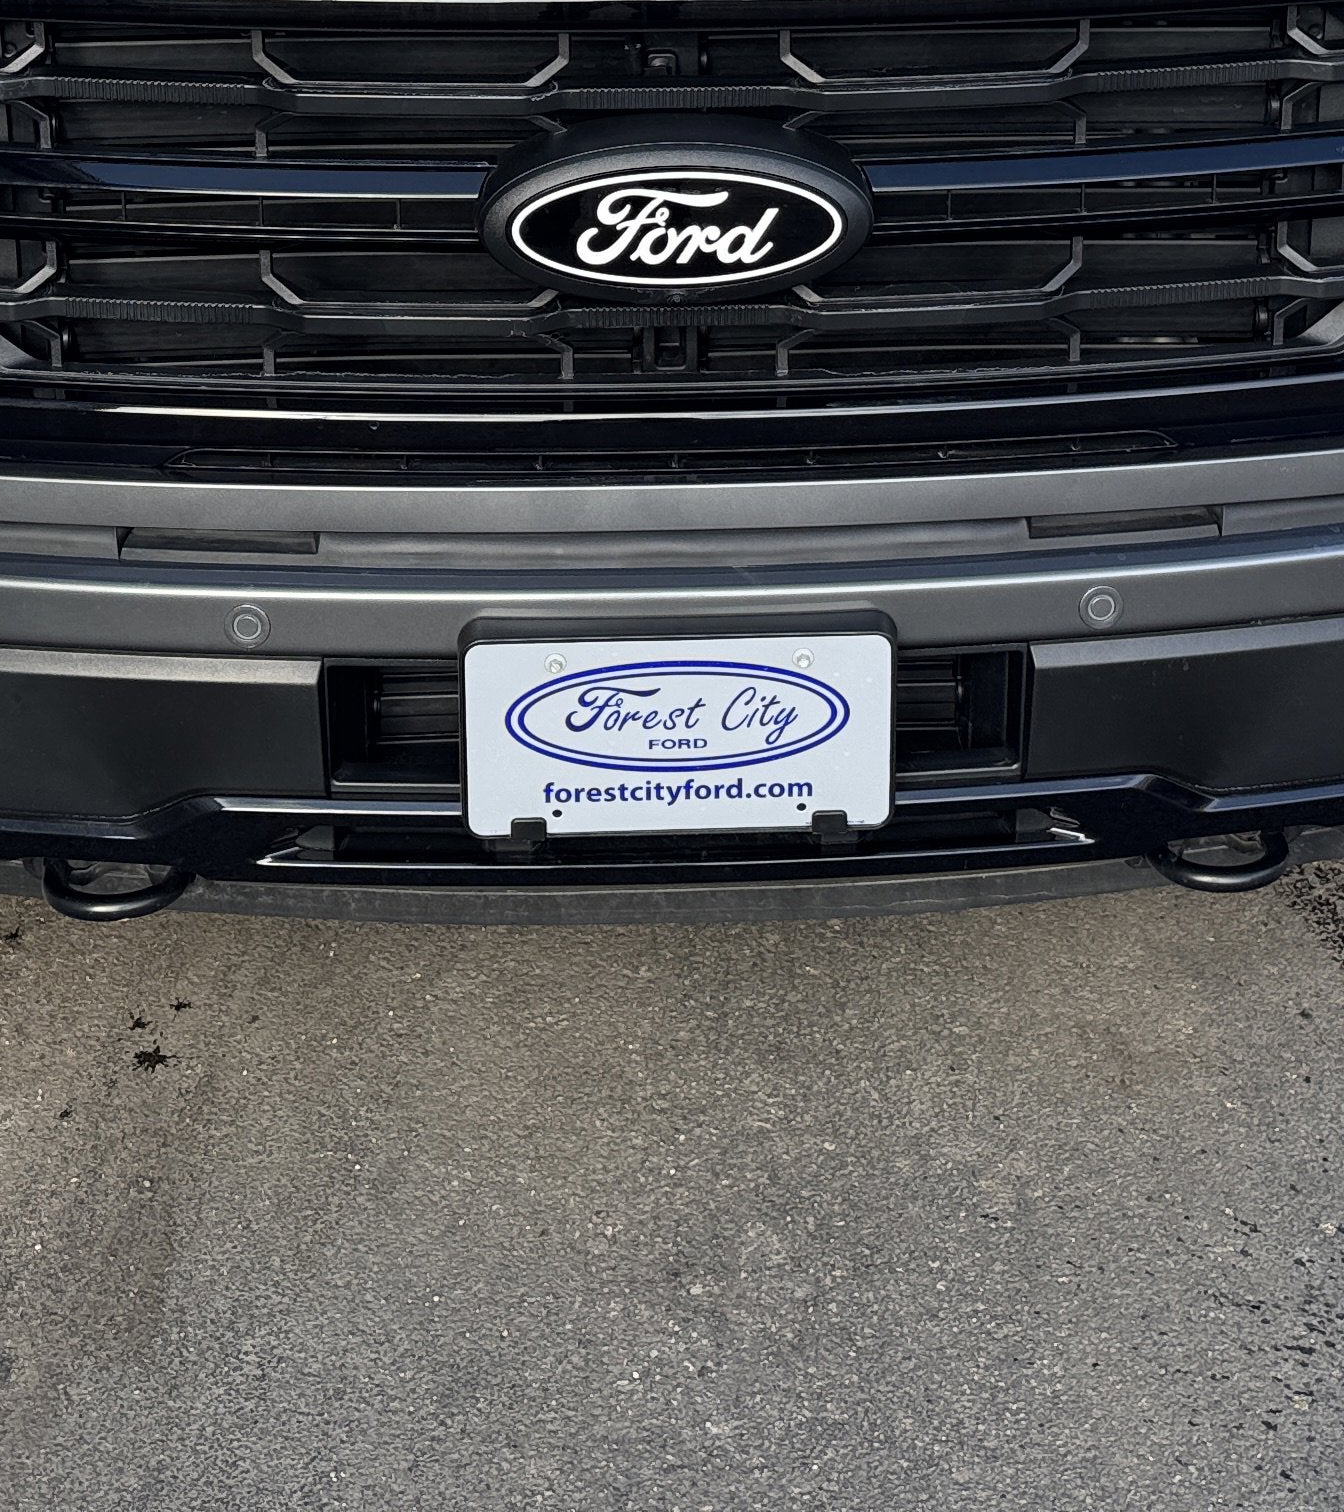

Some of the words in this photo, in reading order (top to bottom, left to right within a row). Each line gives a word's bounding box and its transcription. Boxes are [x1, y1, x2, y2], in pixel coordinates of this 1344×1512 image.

[576, 188, 780, 265] Ford
[565, 686, 707, 732] Forest
[721, 686, 799, 745] City
[648, 738, 708, 750] FORD
[543, 778, 814, 807] forestcityford.com
